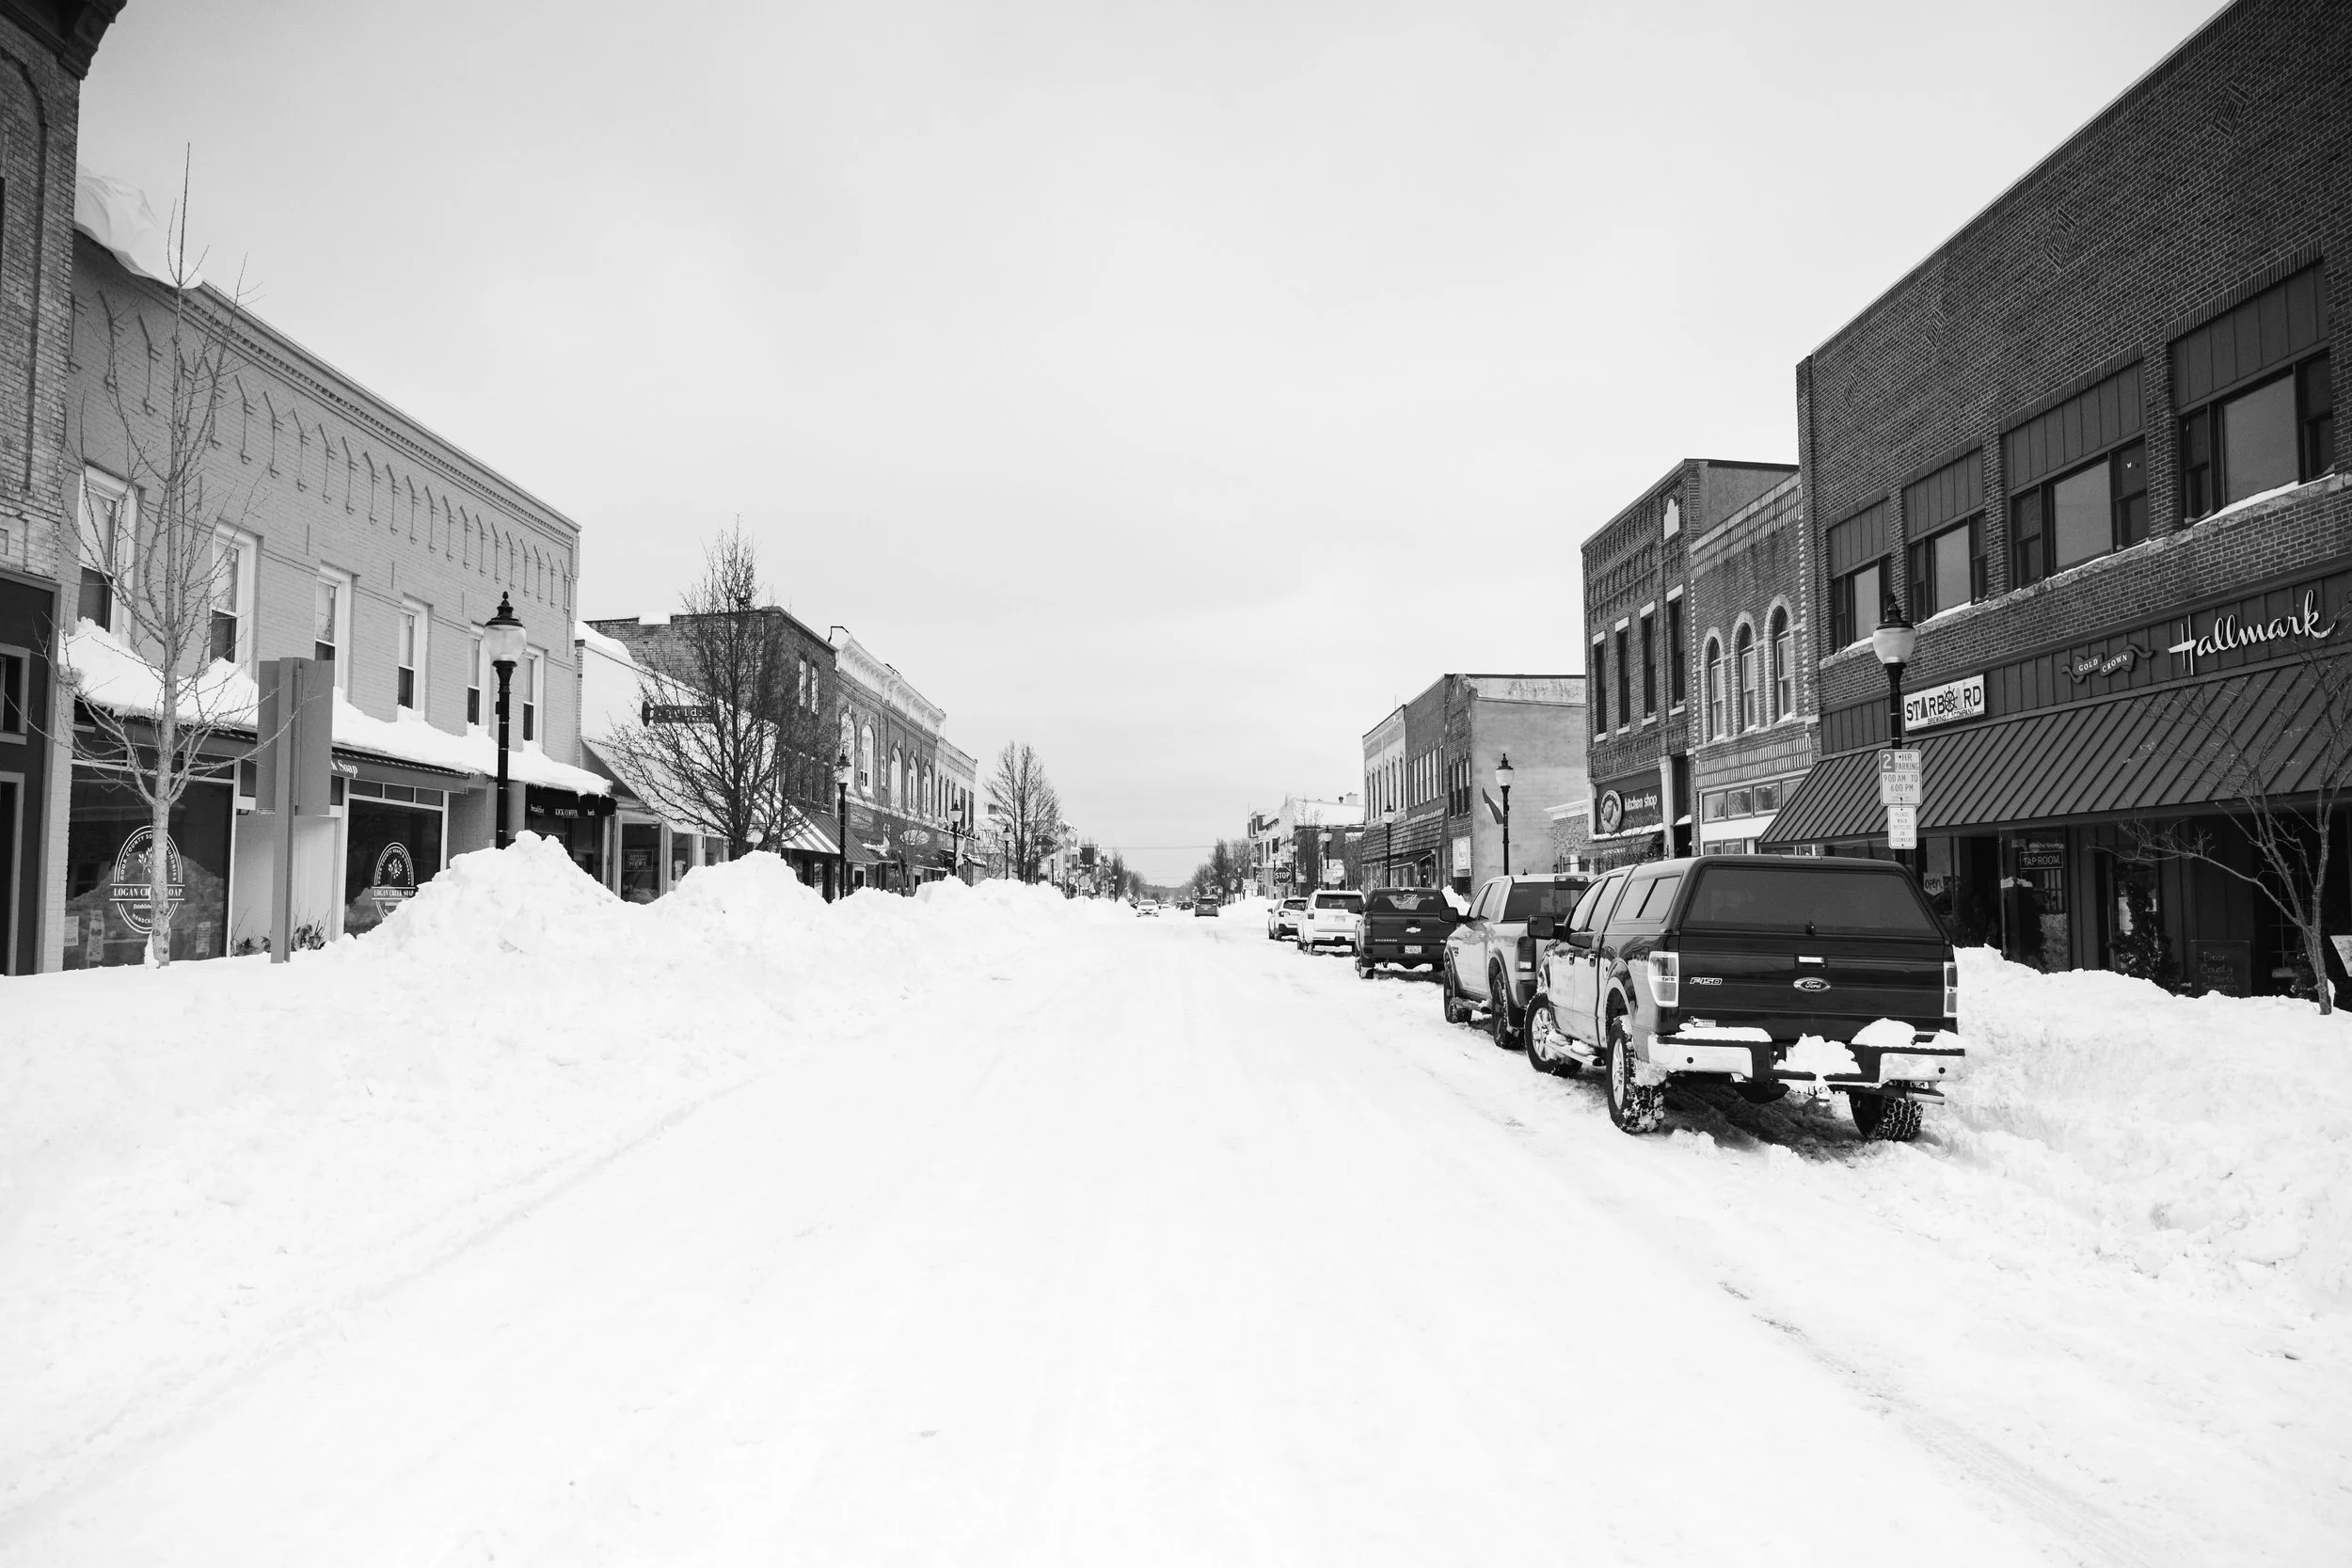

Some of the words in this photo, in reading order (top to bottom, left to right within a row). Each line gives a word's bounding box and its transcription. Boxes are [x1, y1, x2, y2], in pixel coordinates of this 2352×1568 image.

[2168, 590, 2337, 675] Hallmark
[2078, 658, 2099, 672] GOLD
[2102, 654, 2128, 673] CROWN
[1953, 707, 1975, 721] COMPANY
[1883, 753, 1892, 769] 2
[1901, 753, 1913, 762] HR
[338, 759, 358, 778] Soap
[1897, 774, 1906, 783] AM
[1911, 774, 1919, 783] TO
[1904, 784, 1914, 792] PM
[1644, 792, 1658, 810] shop
[125, 836, 145, 857] COUNTY
[2023, 857, 2037, 866] TAP
[2038, 855, 2060, 865] ROOM
[114, 888, 138, 896] LOGAN
[167, 888, 183, 896] OAP
[1804, 980, 1821, 989] Ford
